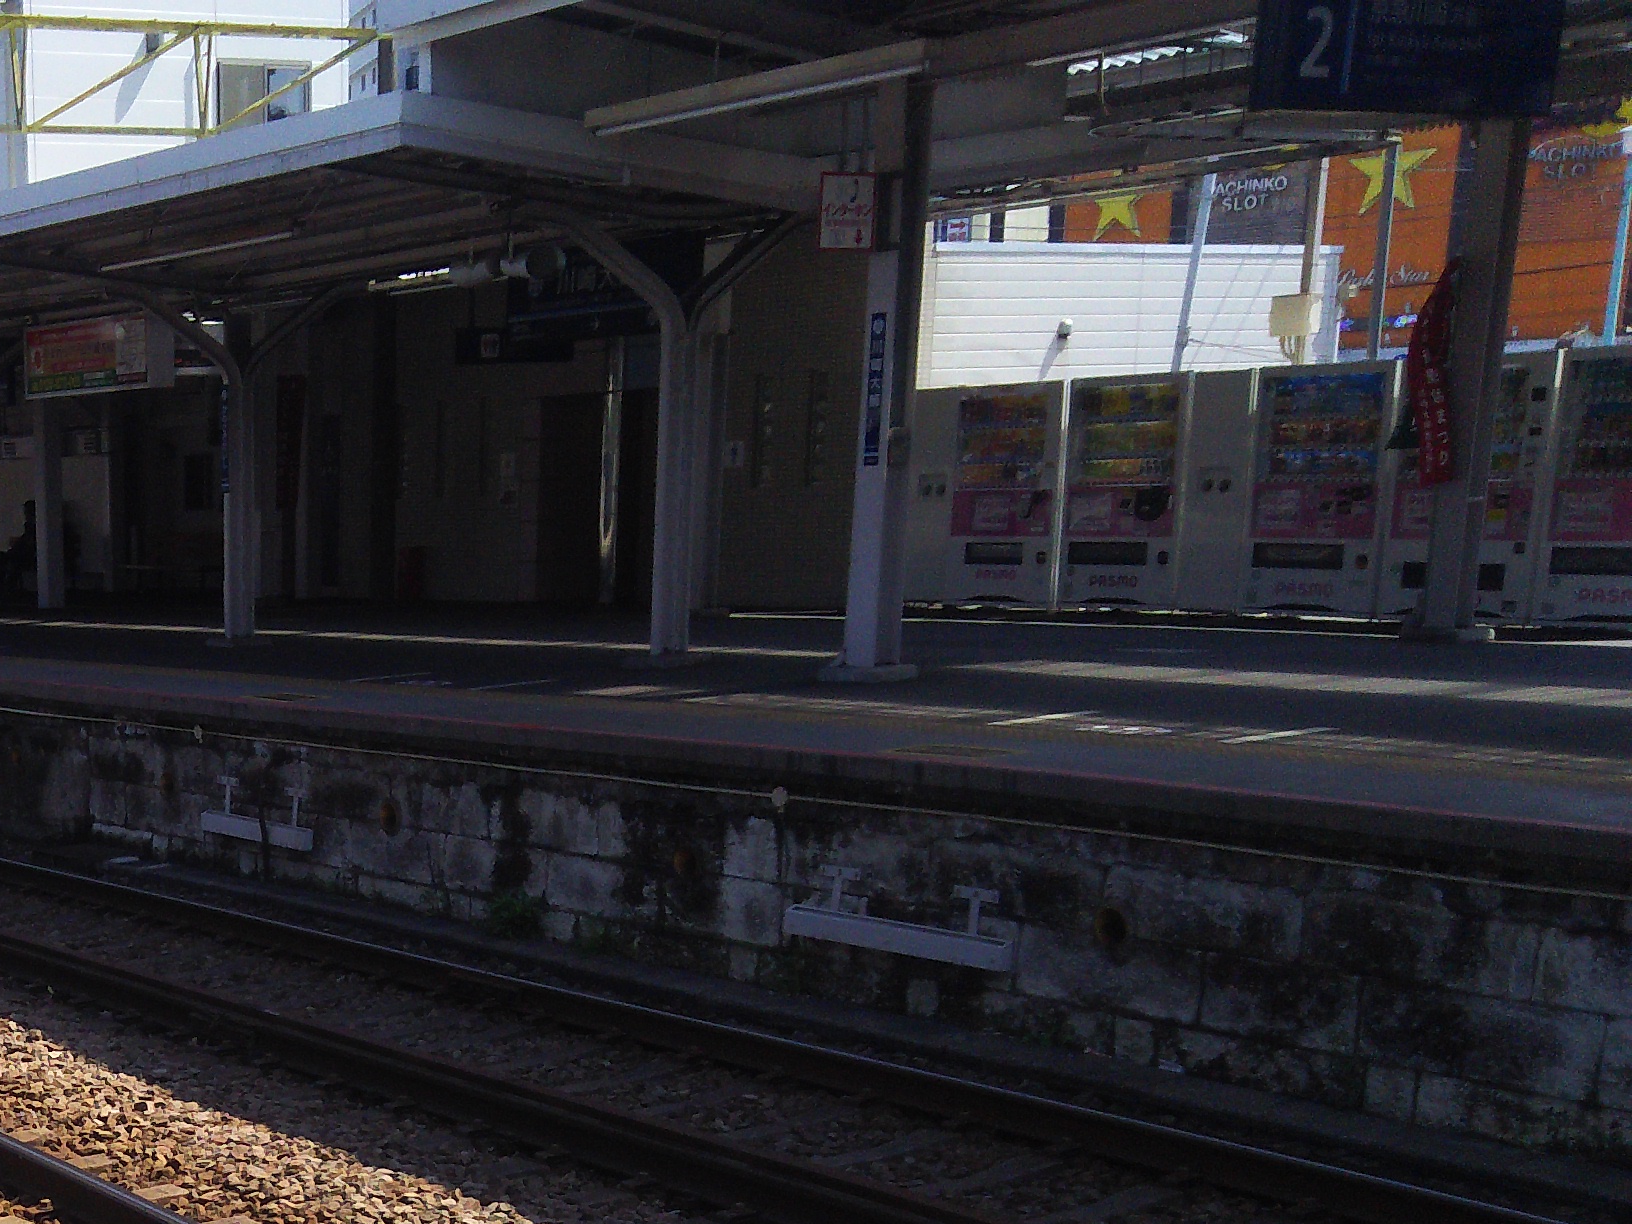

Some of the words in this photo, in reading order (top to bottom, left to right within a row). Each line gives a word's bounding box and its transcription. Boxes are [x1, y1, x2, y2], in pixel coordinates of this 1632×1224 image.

[1299, 6, 1334, 78] 2
[1214, 175, 1289, 197] ACHINKO
[1222, 193, 1269, 211] SLOT
[1088, 574, 1139, 588] PASMO
[1576, 586, 1632, 605] PASM
